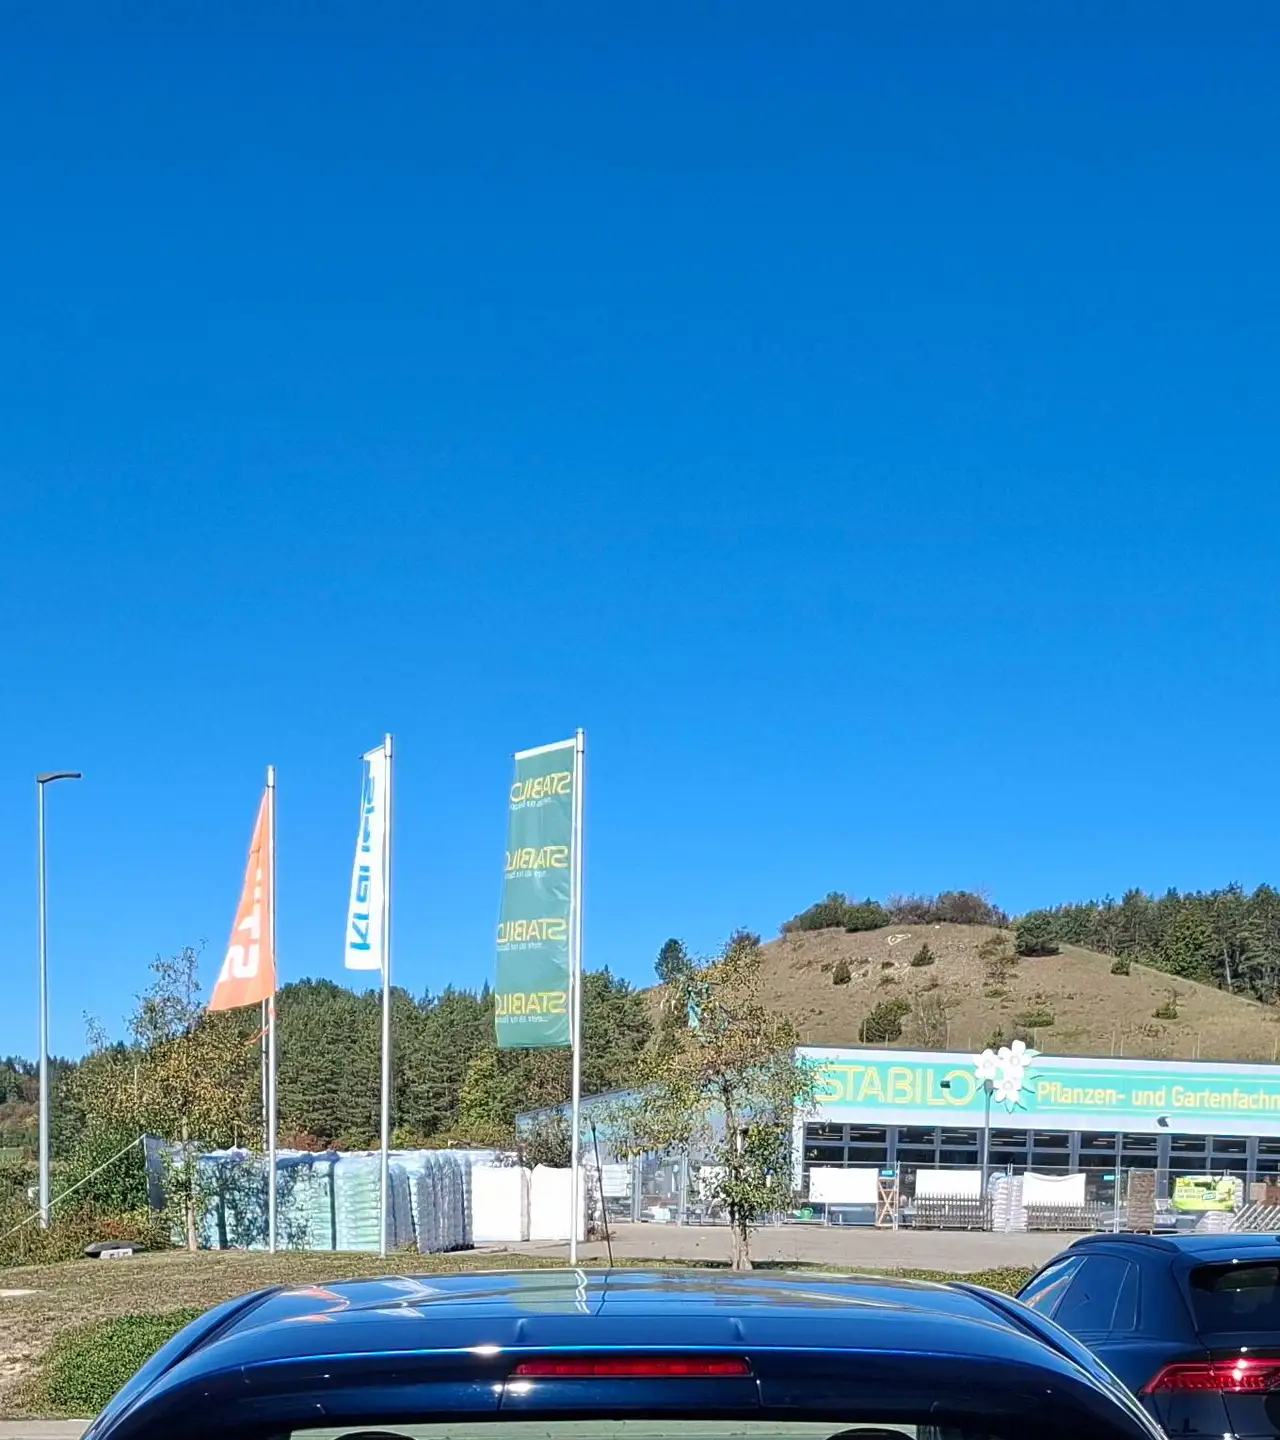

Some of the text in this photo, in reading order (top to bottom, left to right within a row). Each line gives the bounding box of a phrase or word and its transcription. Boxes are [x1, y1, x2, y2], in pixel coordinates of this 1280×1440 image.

[816, 1064, 977, 1107] STABILO
[1037, 1081, 1125, 1106] Pflanzen-
[1132, 1086, 1167, 1107] und
